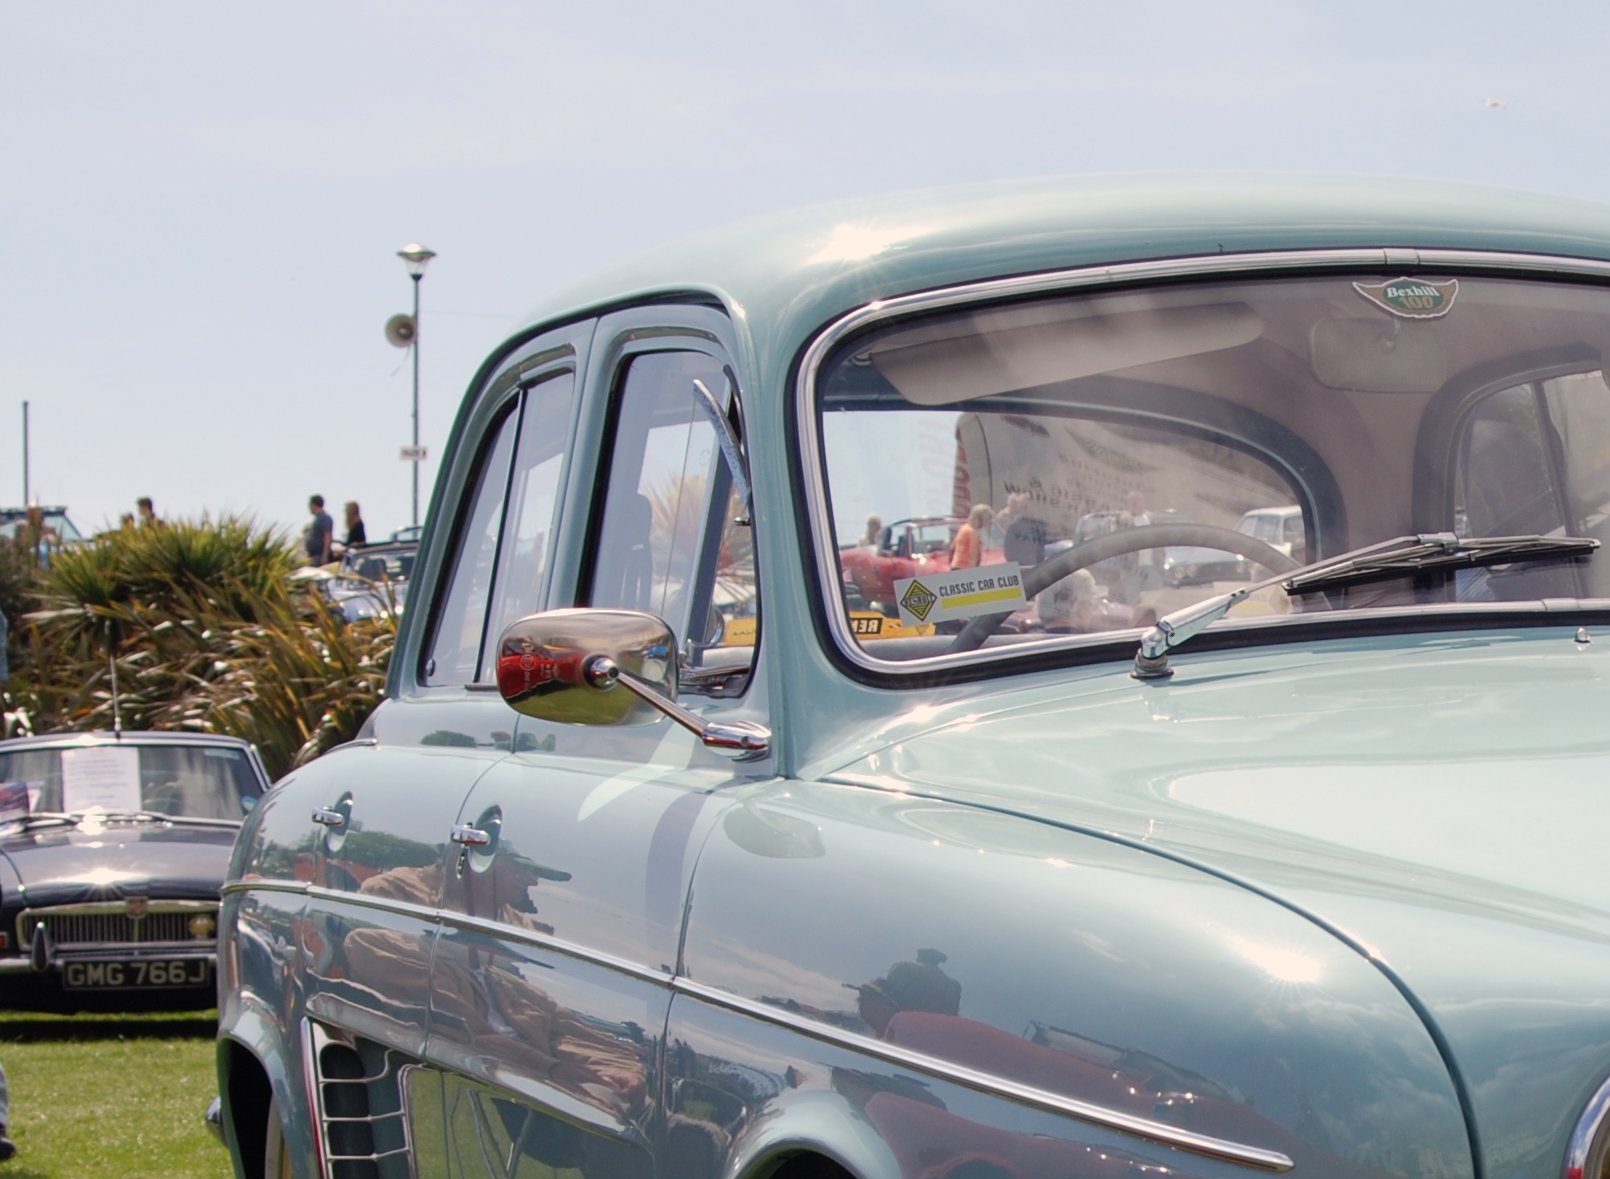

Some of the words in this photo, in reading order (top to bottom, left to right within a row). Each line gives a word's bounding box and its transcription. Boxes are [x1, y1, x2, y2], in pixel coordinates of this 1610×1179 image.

[1386, 286, 1440, 298] Bexhill
[1400, 296, 1434, 309] 100
[939, 581, 976, 598] CLASSIC
[978, 579, 995, 592] CAR
[997, 574, 1020, 588] CLUB
[67, 963, 124, 986] GMG
[130, 961, 206, 985] 766J
